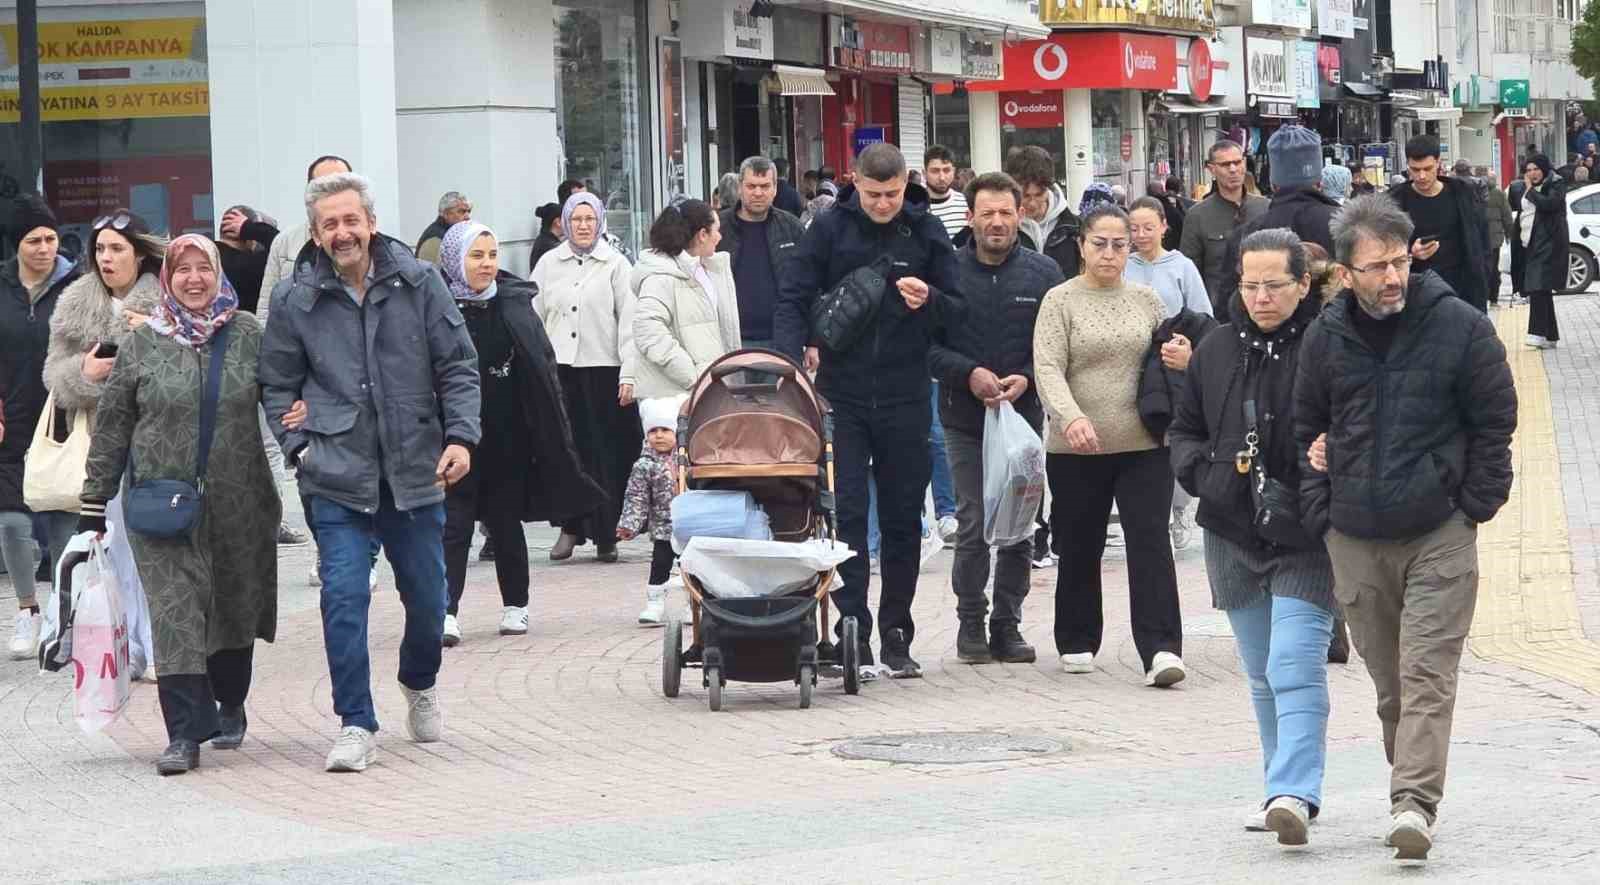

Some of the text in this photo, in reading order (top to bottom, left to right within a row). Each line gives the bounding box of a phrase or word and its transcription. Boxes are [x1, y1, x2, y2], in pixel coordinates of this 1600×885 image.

[37, 38, 184, 59] OK KAMPANYA
[105, 95, 116, 109] 9
[121, 93, 144, 108] AY
[1018, 103, 1058, 113] vodafone
